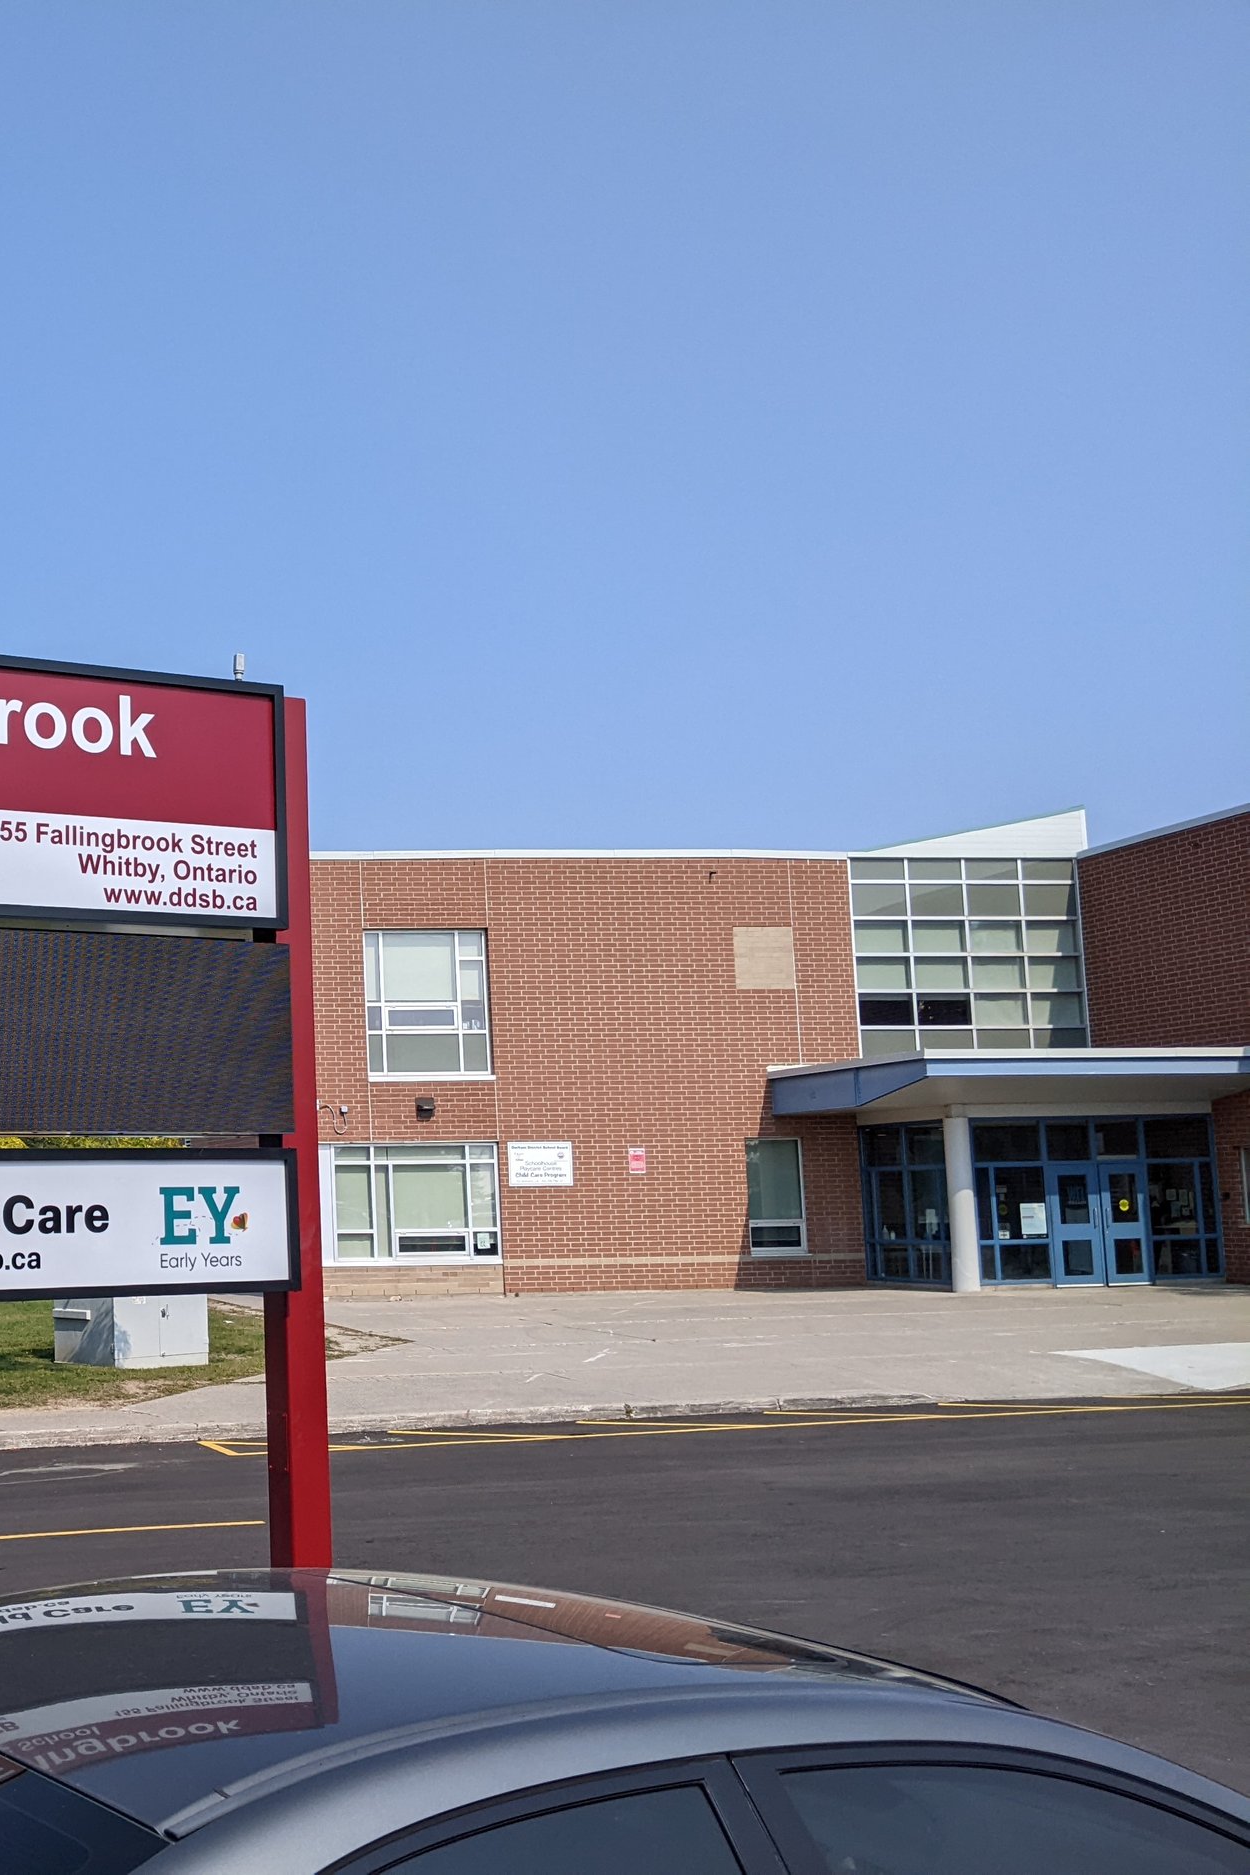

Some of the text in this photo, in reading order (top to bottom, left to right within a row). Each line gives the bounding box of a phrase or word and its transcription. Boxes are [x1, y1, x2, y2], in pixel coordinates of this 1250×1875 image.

[35, 822, 184, 853] Fallingbrook
[190, 834, 258, 859] Street
[78, 853, 258, 885] Whitby, Ontario
[103, 886, 258, 912] www.ddsb.ca
[2, 1194, 110, 1234] Care
[159, 1186, 240, 1245] EY
[160, 1253, 243, 1272] Early Years
